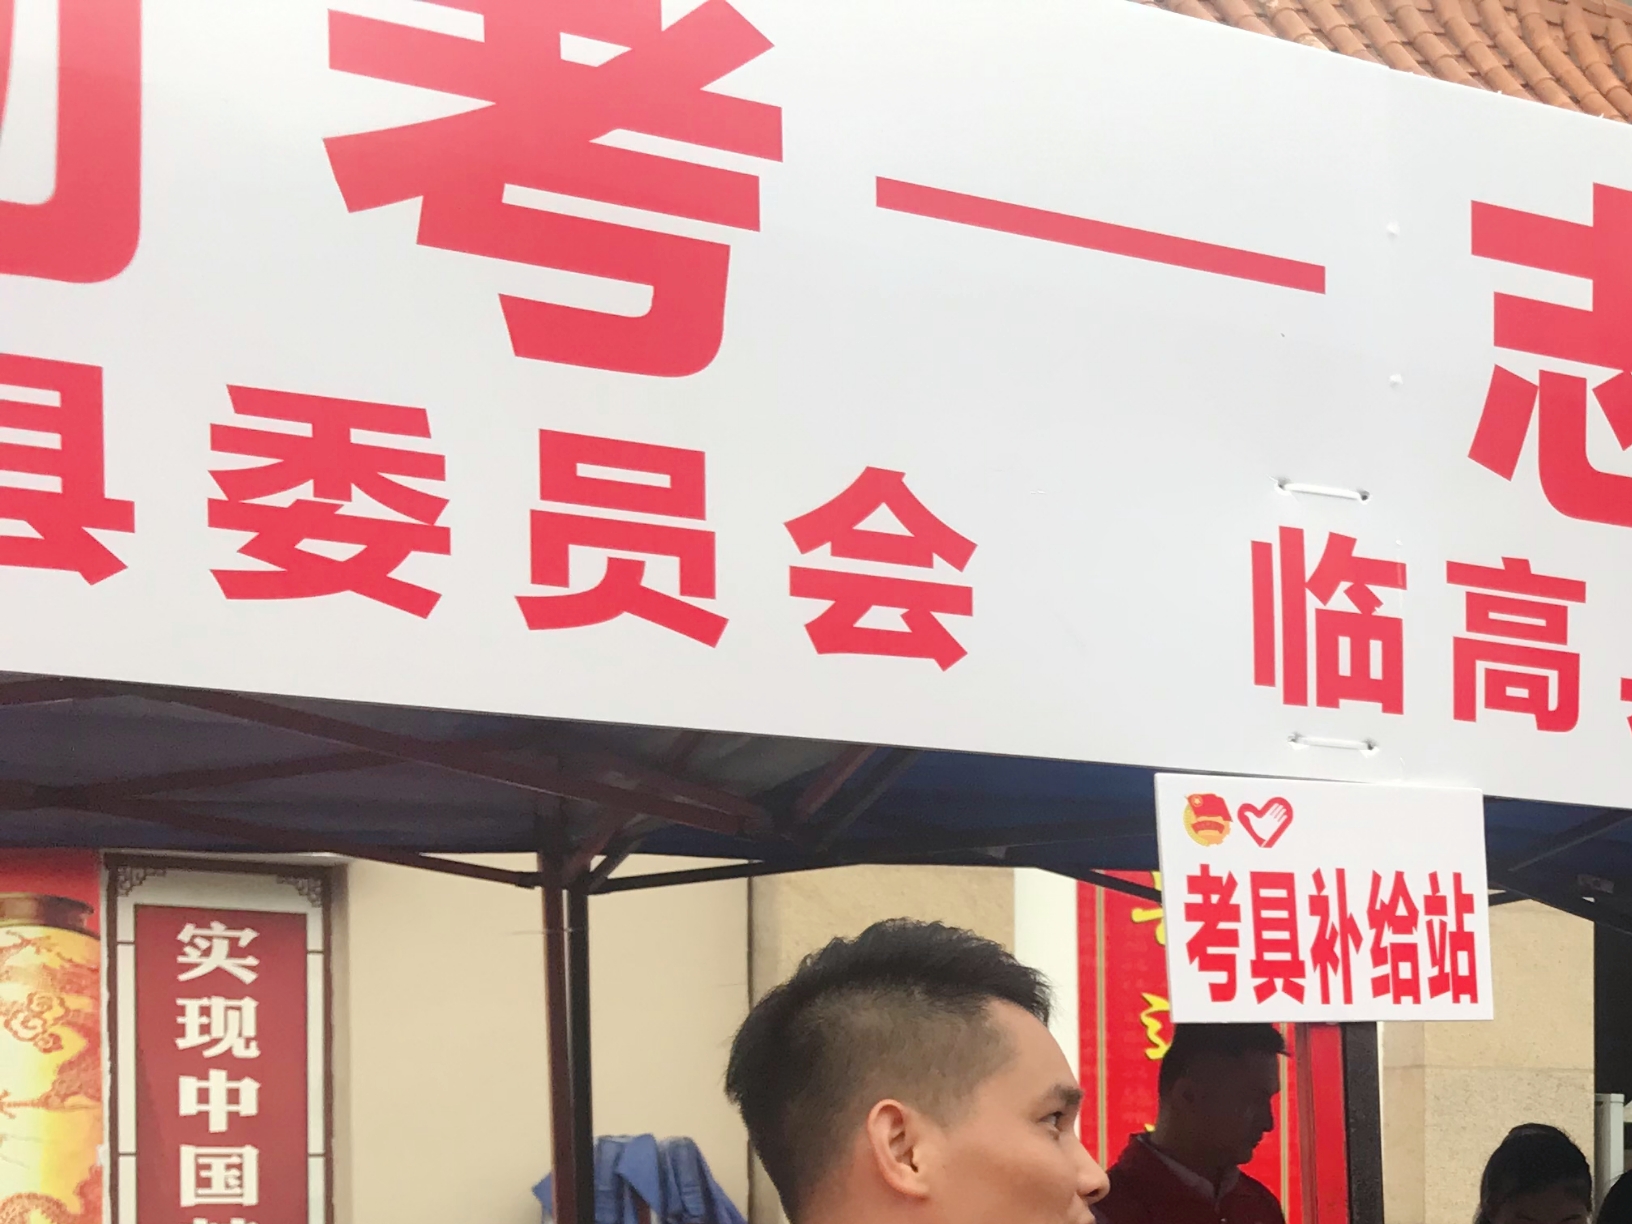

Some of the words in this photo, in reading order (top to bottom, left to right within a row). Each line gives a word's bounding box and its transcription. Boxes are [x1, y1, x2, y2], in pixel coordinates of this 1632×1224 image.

[1185, 864, 1479, 1005] 考具补给站
